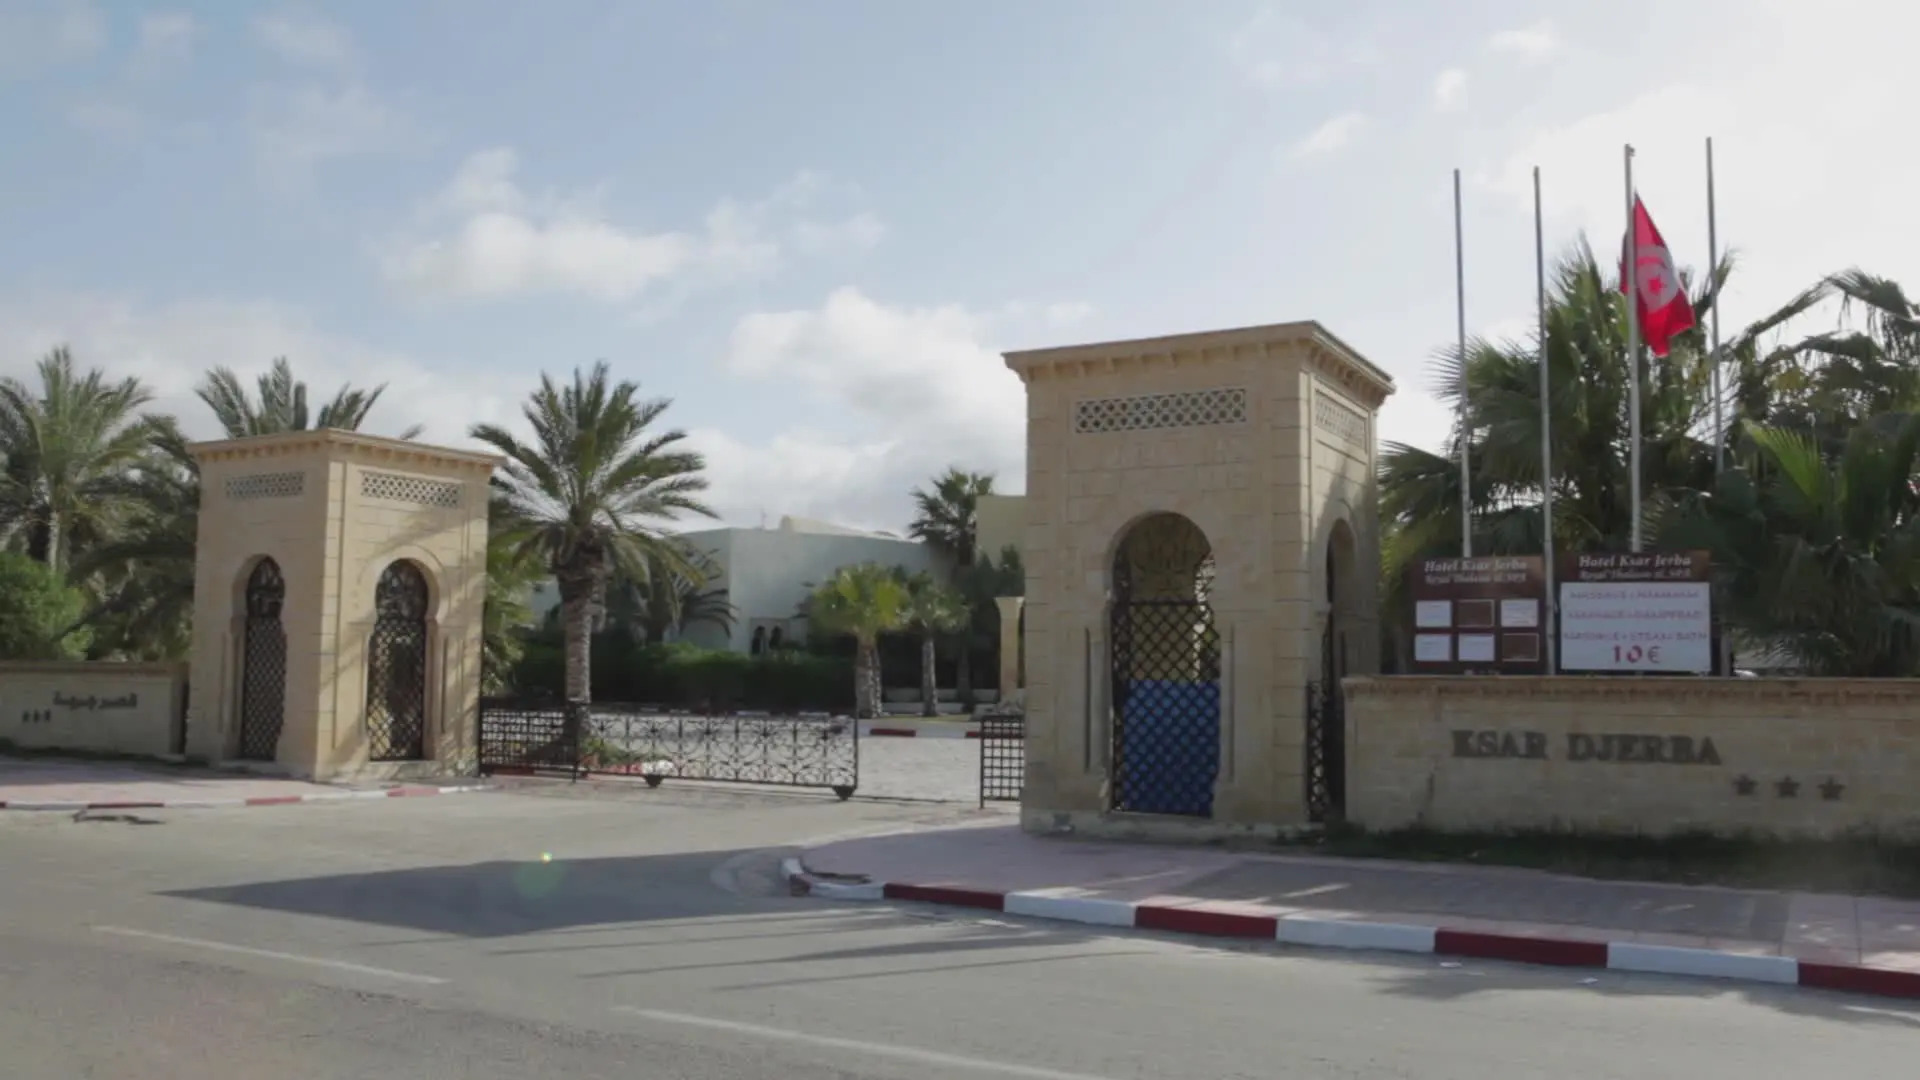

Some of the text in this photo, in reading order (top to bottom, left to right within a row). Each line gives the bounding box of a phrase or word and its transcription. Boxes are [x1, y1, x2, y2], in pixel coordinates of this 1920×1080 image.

[1424, 559, 1458, 572] Hotel
[1579, 554, 1615, 567] Hotel
[1451, 730, 1721, 765] KSAR DJERBA
